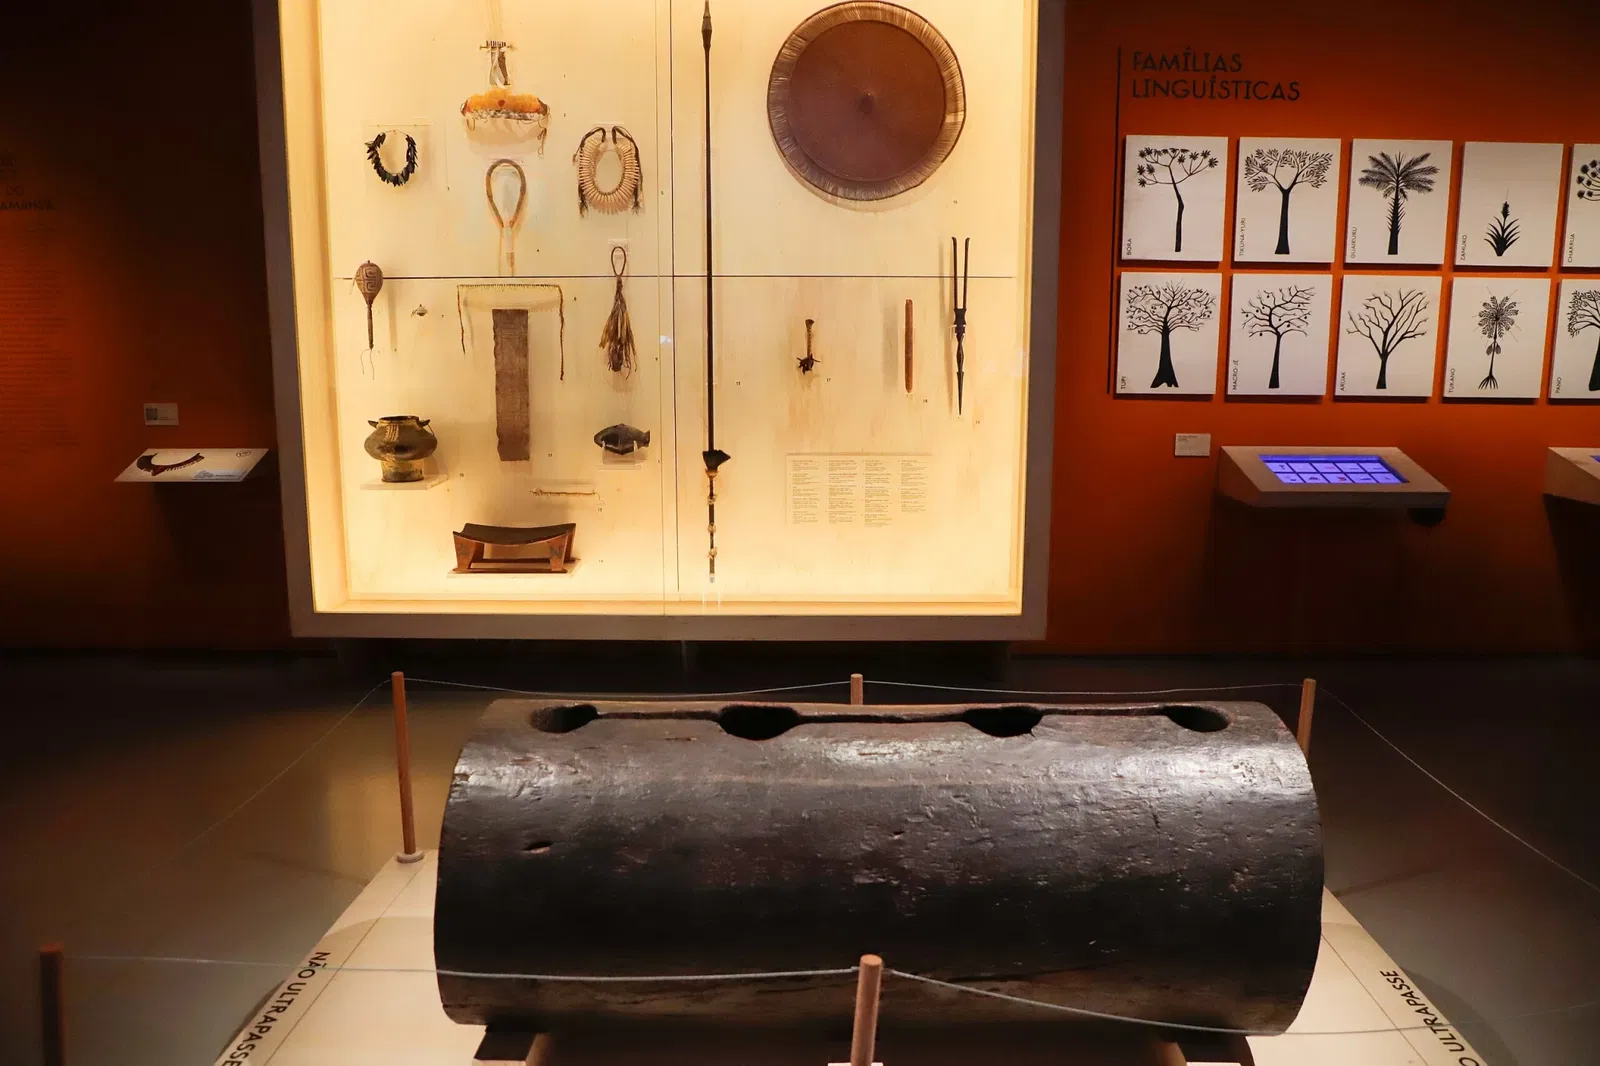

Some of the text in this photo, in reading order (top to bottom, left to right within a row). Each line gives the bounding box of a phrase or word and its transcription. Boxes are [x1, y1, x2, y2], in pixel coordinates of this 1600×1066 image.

[1132, 46, 1243, 73] FAMÍLIAS
[1131, 76, 1300, 101] LINGUÍSTICAS
[1238, 216, 1246, 257] TIKUNA-YURI
[1350, 226, 1358, 259] GUAIKURU
[1460, 234, 1468, 260] ZAMUKO
[1567, 232, 1575, 264] CHARRUA
[1448, 367, 1456, 394] TUKANO
[1555, 375, 1563, 394] PANO
[221, 952, 331, 1066] NÃO ULTRAPASSE
[1379, 970, 1465, 1052] ULTRAPASSE
